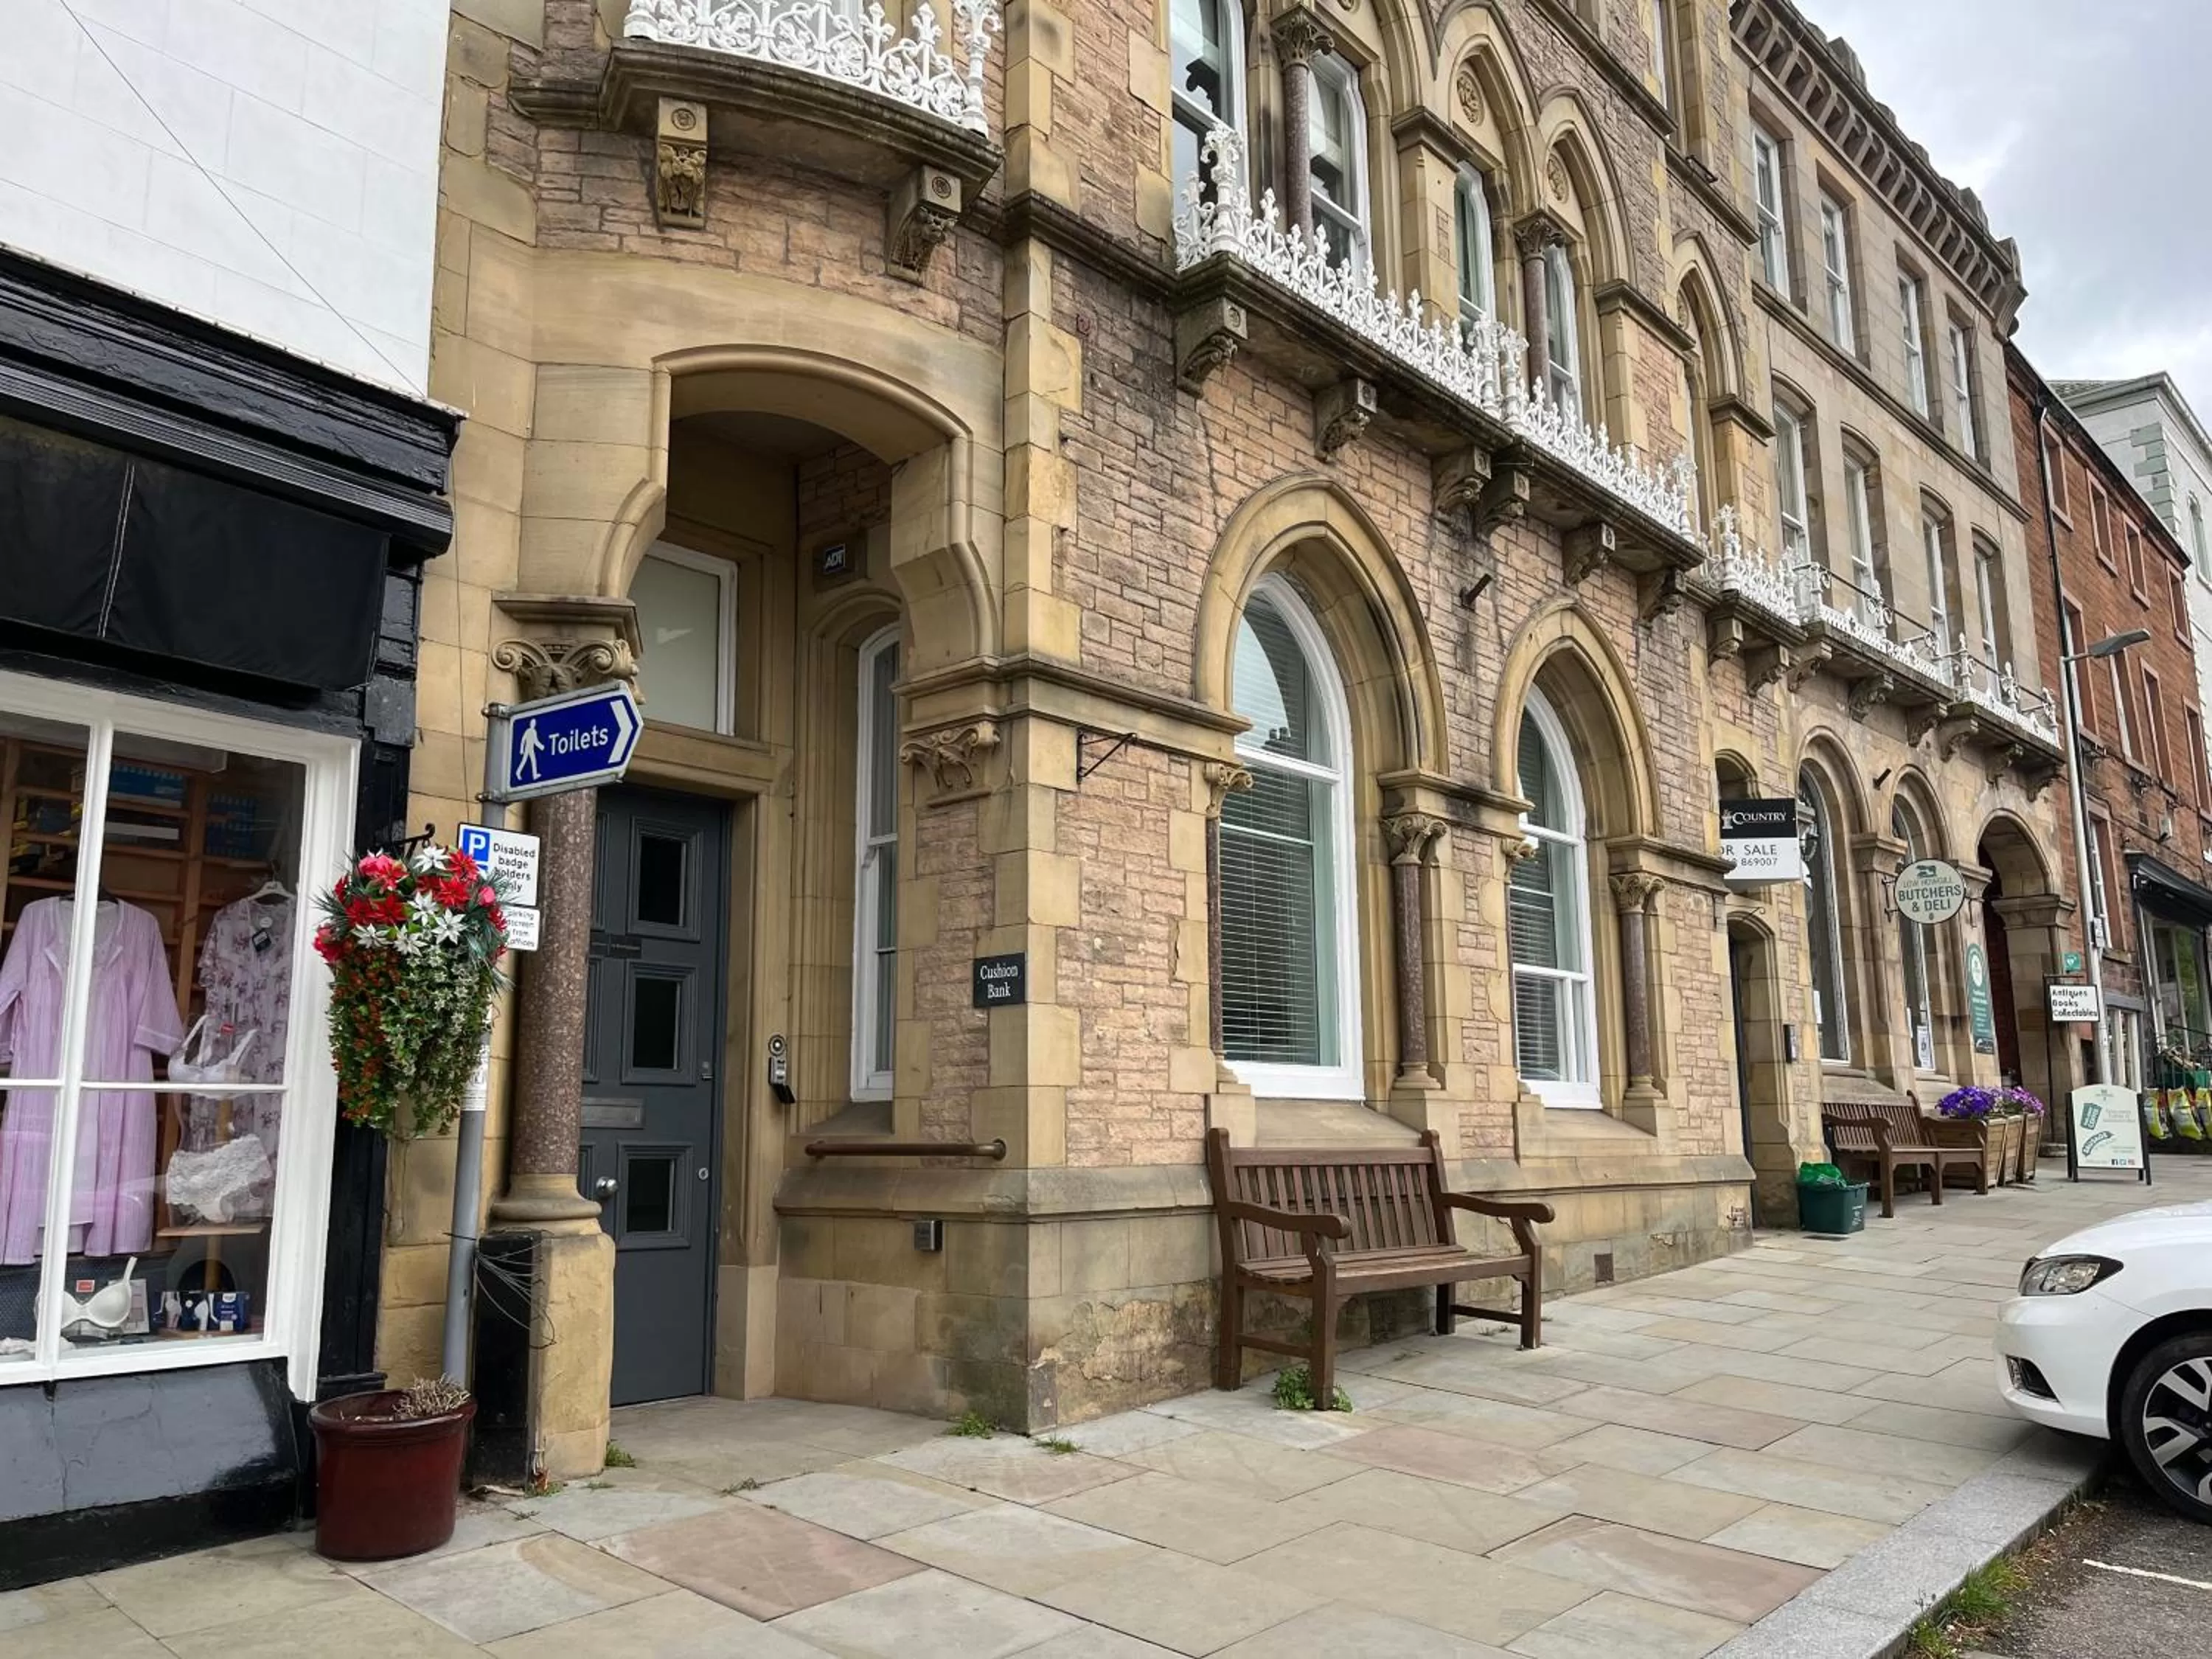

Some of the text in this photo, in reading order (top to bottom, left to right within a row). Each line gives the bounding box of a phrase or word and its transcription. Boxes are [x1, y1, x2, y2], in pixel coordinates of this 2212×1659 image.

[549, 725, 608, 756] Toilets
[1732, 812, 1787, 824] COUNTRY
[468, 832, 486, 857] P
[493, 843, 536, 858] Disabled
[1744, 844, 1778, 856] SALE
[498, 856, 529, 869] badge
[1741, 858, 1778, 867] 869007
[494, 866, 532, 880] holders
[504, 880, 523, 893] nly
[1898, 884, 1962, 902] BUTCHERS
[1912, 899, 1951, 912] & DELI
[987, 981, 1012, 999] Bank
[2052, 989, 2088, 999] Antiques
[2052, 998, 2079, 1008] Books
[2053, 1008, 2098, 1017] Collectables
